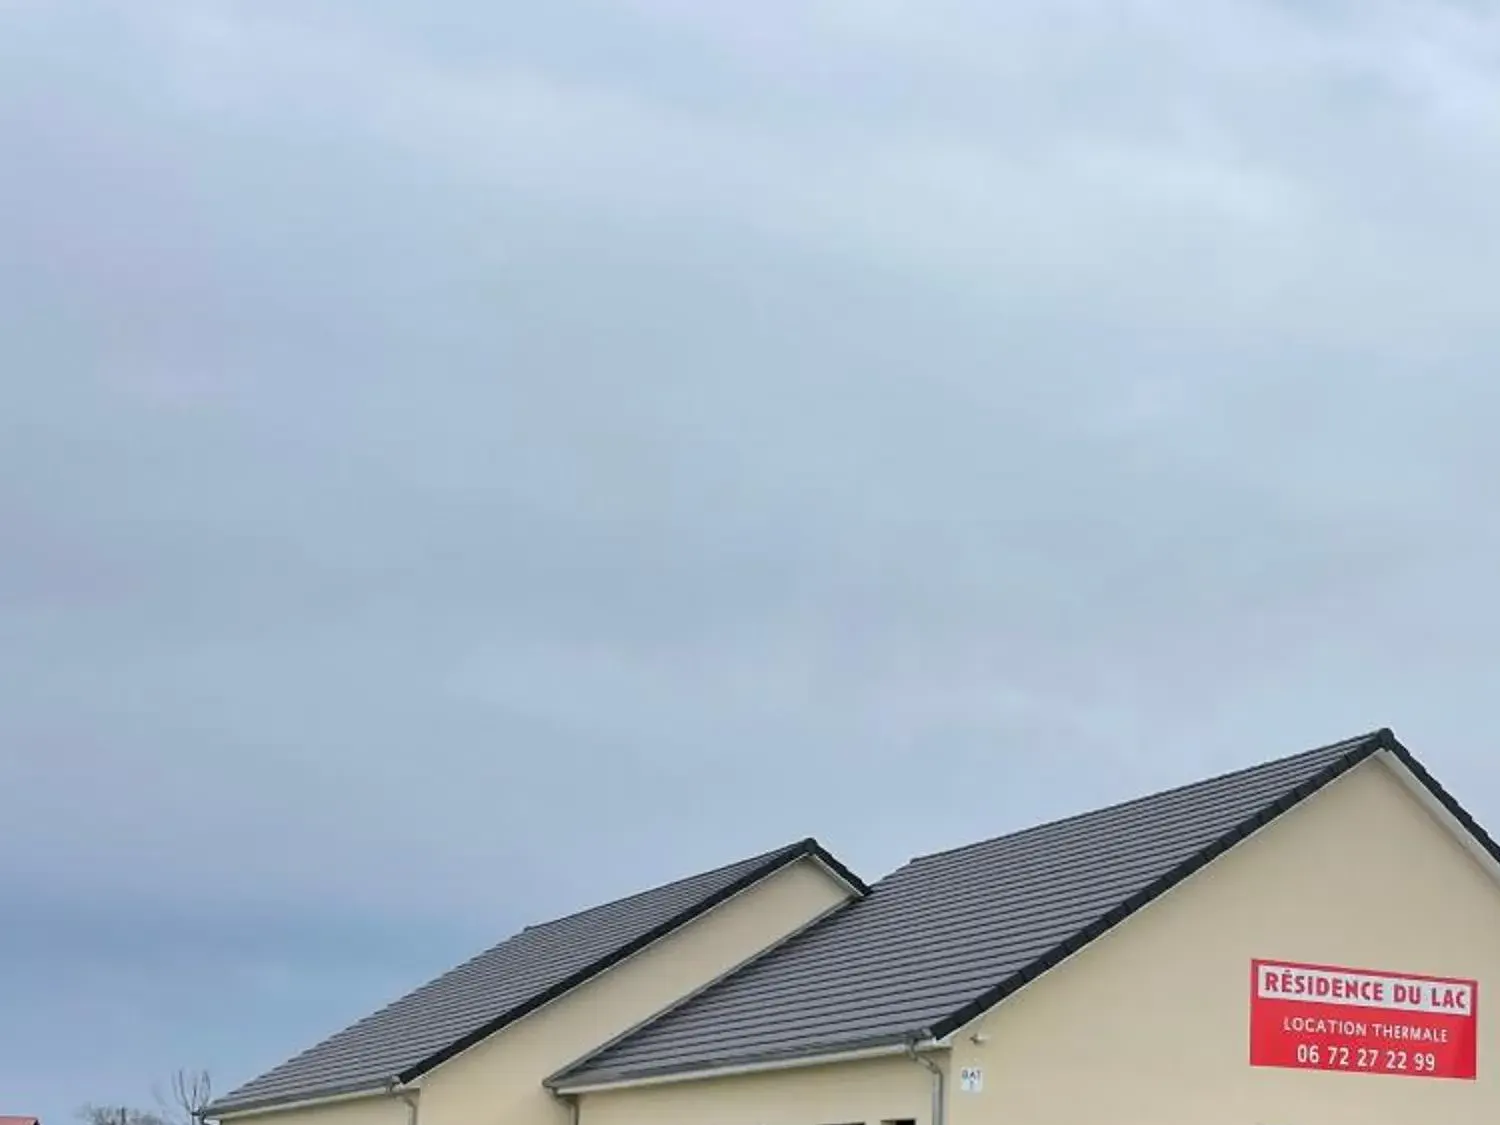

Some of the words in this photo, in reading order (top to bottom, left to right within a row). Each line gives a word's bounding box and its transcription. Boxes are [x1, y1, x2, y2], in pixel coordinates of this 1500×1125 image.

[1265, 969, 1384, 1001] RÉSIDENCE
[1393, 983, 1421, 1005] DU
[1431, 988, 1467, 1009] LAC
[1283, 1016, 1367, 1037] LOCATION
[1372, 1023, 1448, 1043] THERMALE
[1297, 1044, 1319, 1063] 06
[1327, 1046, 1349, 1066] 72
[1357, 1048, 1379, 1068] 27
[1386, 1050, 1407, 1070] 22
[1413, 1052, 1436, 1072] 99
